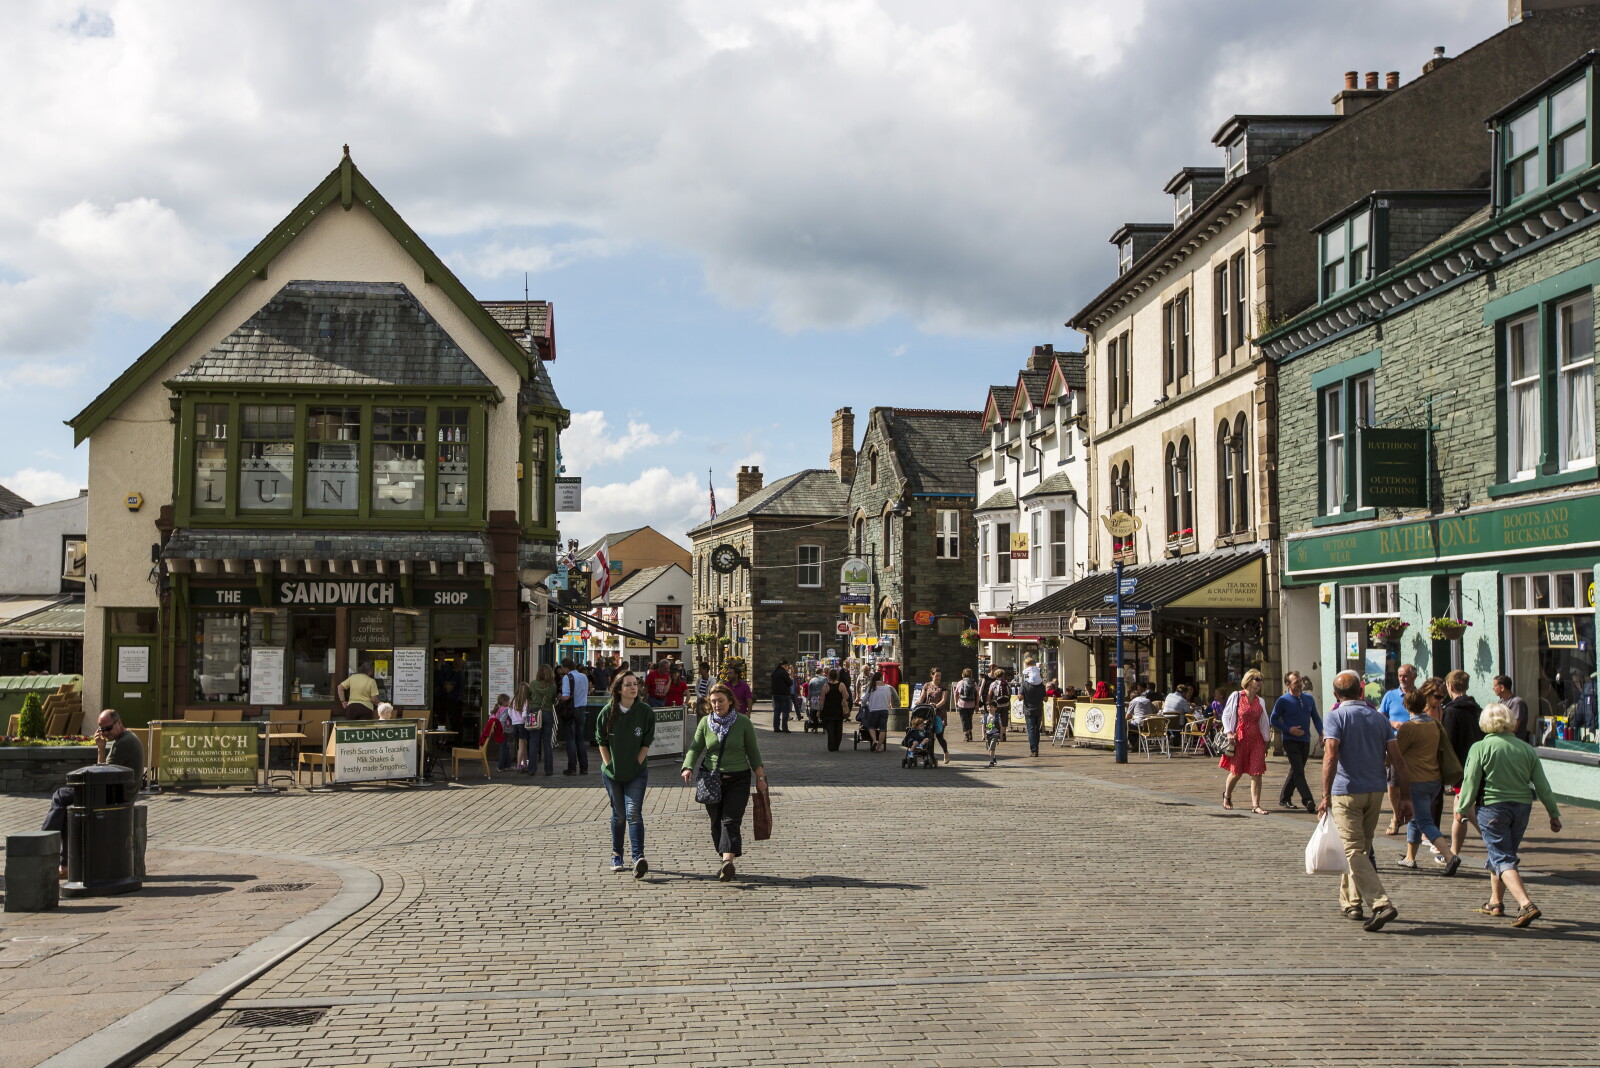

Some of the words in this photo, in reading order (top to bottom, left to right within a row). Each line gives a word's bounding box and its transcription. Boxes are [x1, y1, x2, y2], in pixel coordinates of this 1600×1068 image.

[1368, 441, 1419, 450] RATHBONE
[1370, 476, 1417, 485] OUTDOOR
[1369, 486, 1419, 495] CLOTHING
[1503, 511, 1540, 529] BOOTS
[1543, 506, 1569, 524] AND
[1379, 517, 1480, 555] RATHBONE
[1503, 524, 1569, 545] RUCKSACKS
[1323, 537, 1357, 552] OUTDOOR
[1329, 551, 1350, 563] WEAR
[216, 591, 241, 603] THE
[281, 582, 394, 604] SANDWICH
[434, 592, 468, 604] SHOP
[360, 613, 383, 623] salads
[358, 625, 384, 633] coffees
[352, 635, 367, 643] cold
[369, 635, 390, 643] drinks
[1550, 632, 1574, 641] Barbour
[340, 748, 357, 756] Fresh
[357, 746, 378, 755] Scones
[378, 746, 384, 754] &
[356, 756, 368, 764] Milk
[369, 755, 389, 763] Shakes
[389, 754, 395, 762] &
[168, 767, 184, 775] THE
[186, 766, 227, 775] SANDWICH
[343, 766, 362, 774] freshly
[362, 764, 379, 772] made
[379, 763, 408, 772] Smoothies
